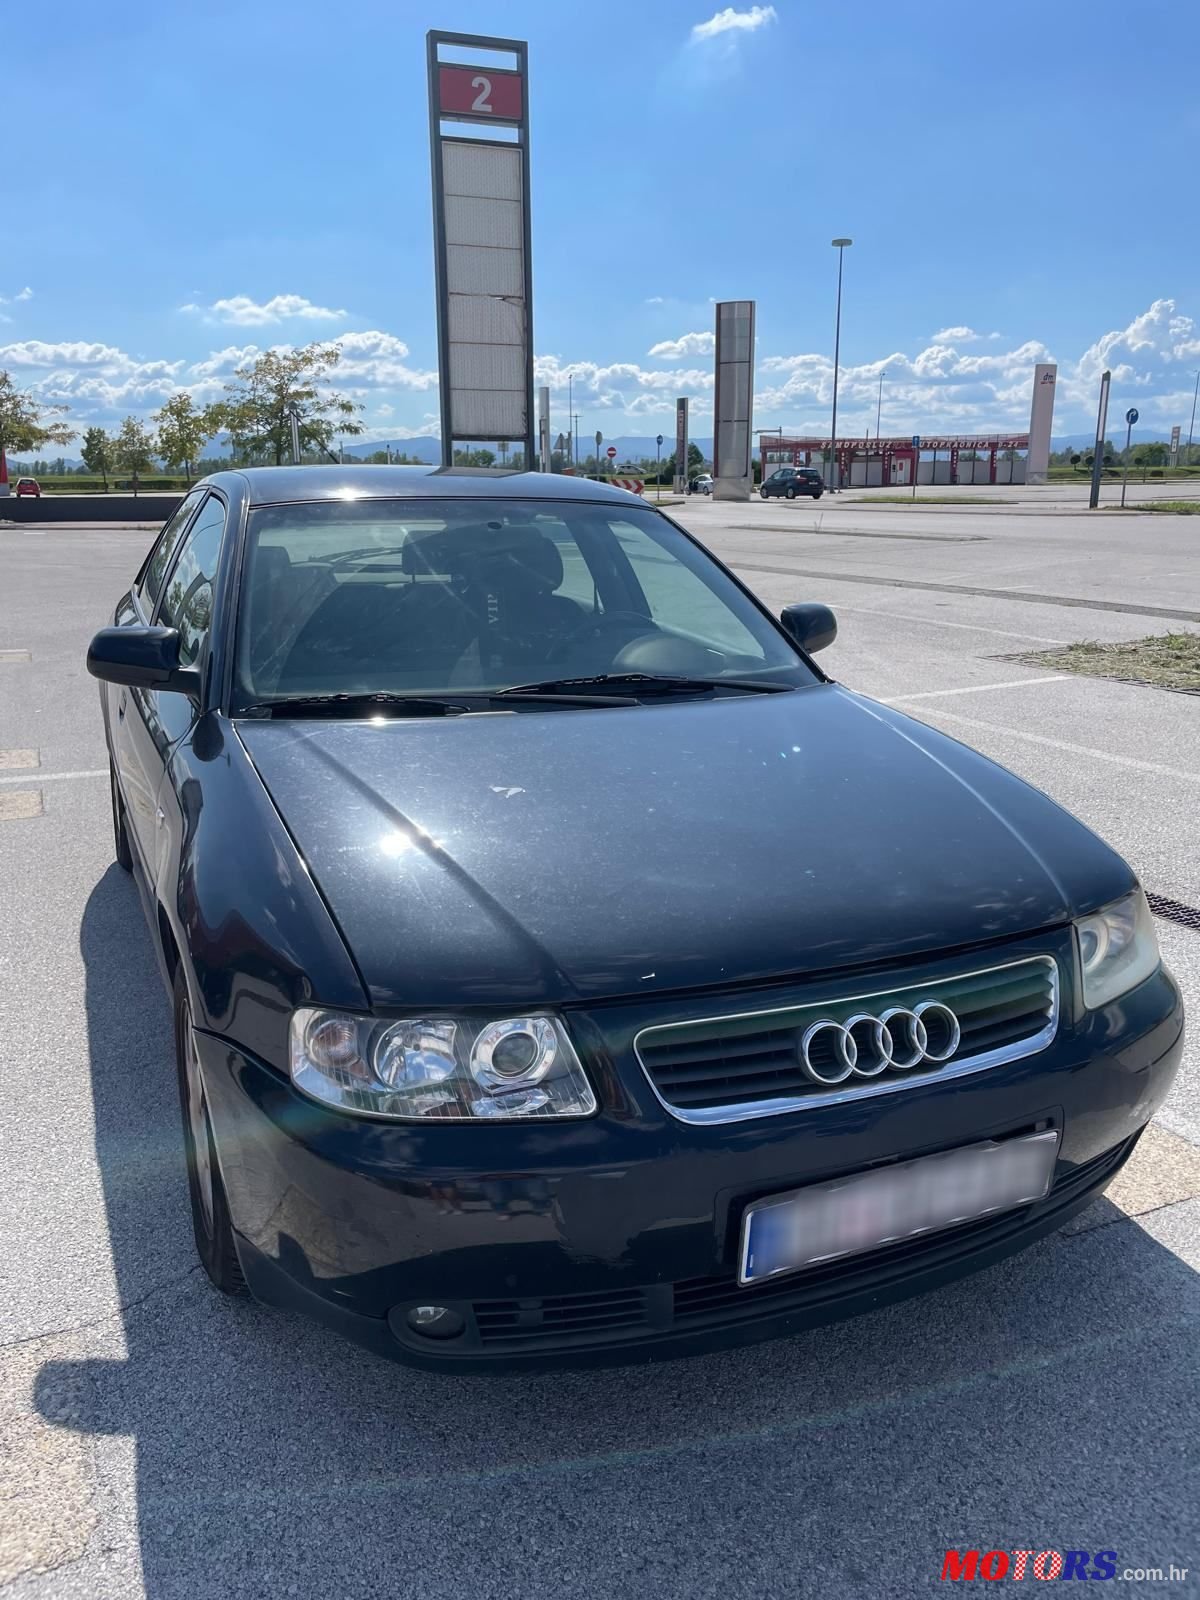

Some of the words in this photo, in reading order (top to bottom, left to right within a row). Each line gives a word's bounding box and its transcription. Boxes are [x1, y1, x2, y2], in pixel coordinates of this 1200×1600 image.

[471, 76, 493, 112] 2
[1043, 372, 1054, 381] dm
[913, 441, 989, 449] UTOPRAONICA
[487, 593, 499, 625] VIP
